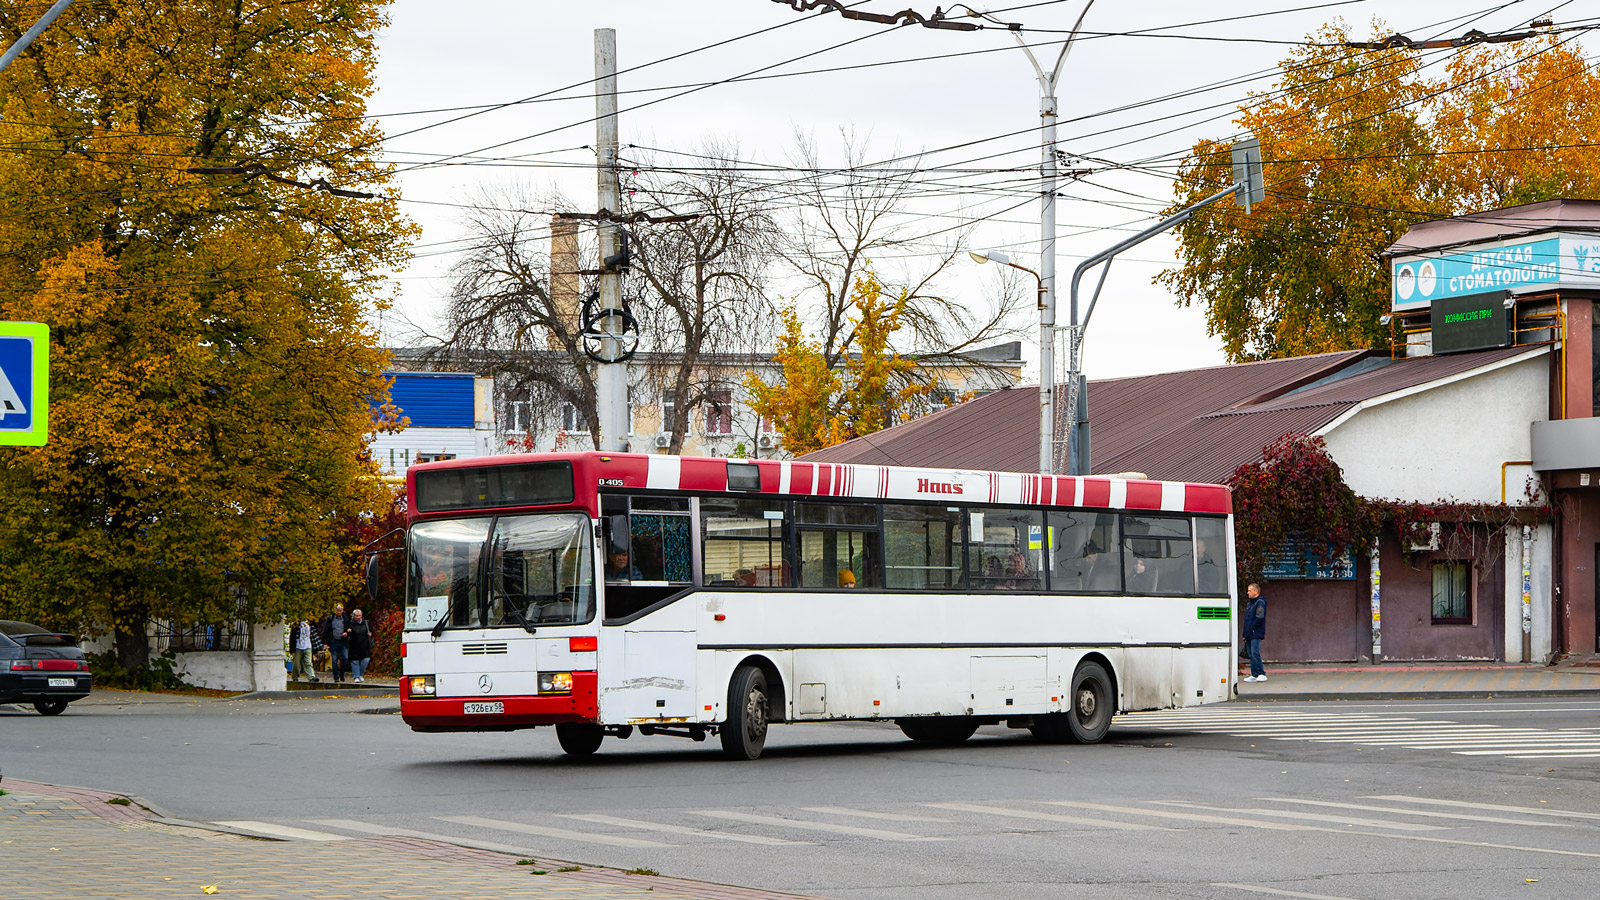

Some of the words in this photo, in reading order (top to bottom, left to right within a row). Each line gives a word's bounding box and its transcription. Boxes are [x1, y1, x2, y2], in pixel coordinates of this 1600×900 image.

[1471, 245, 1533, 272] ДЕТСКАЯ
[1449, 261, 1557, 292] СТОМАТОЛОГИЯ
[917, 478, 963, 494] Haas
[406, 608, 418, 624] 32
[426, 609, 438, 623] 32
